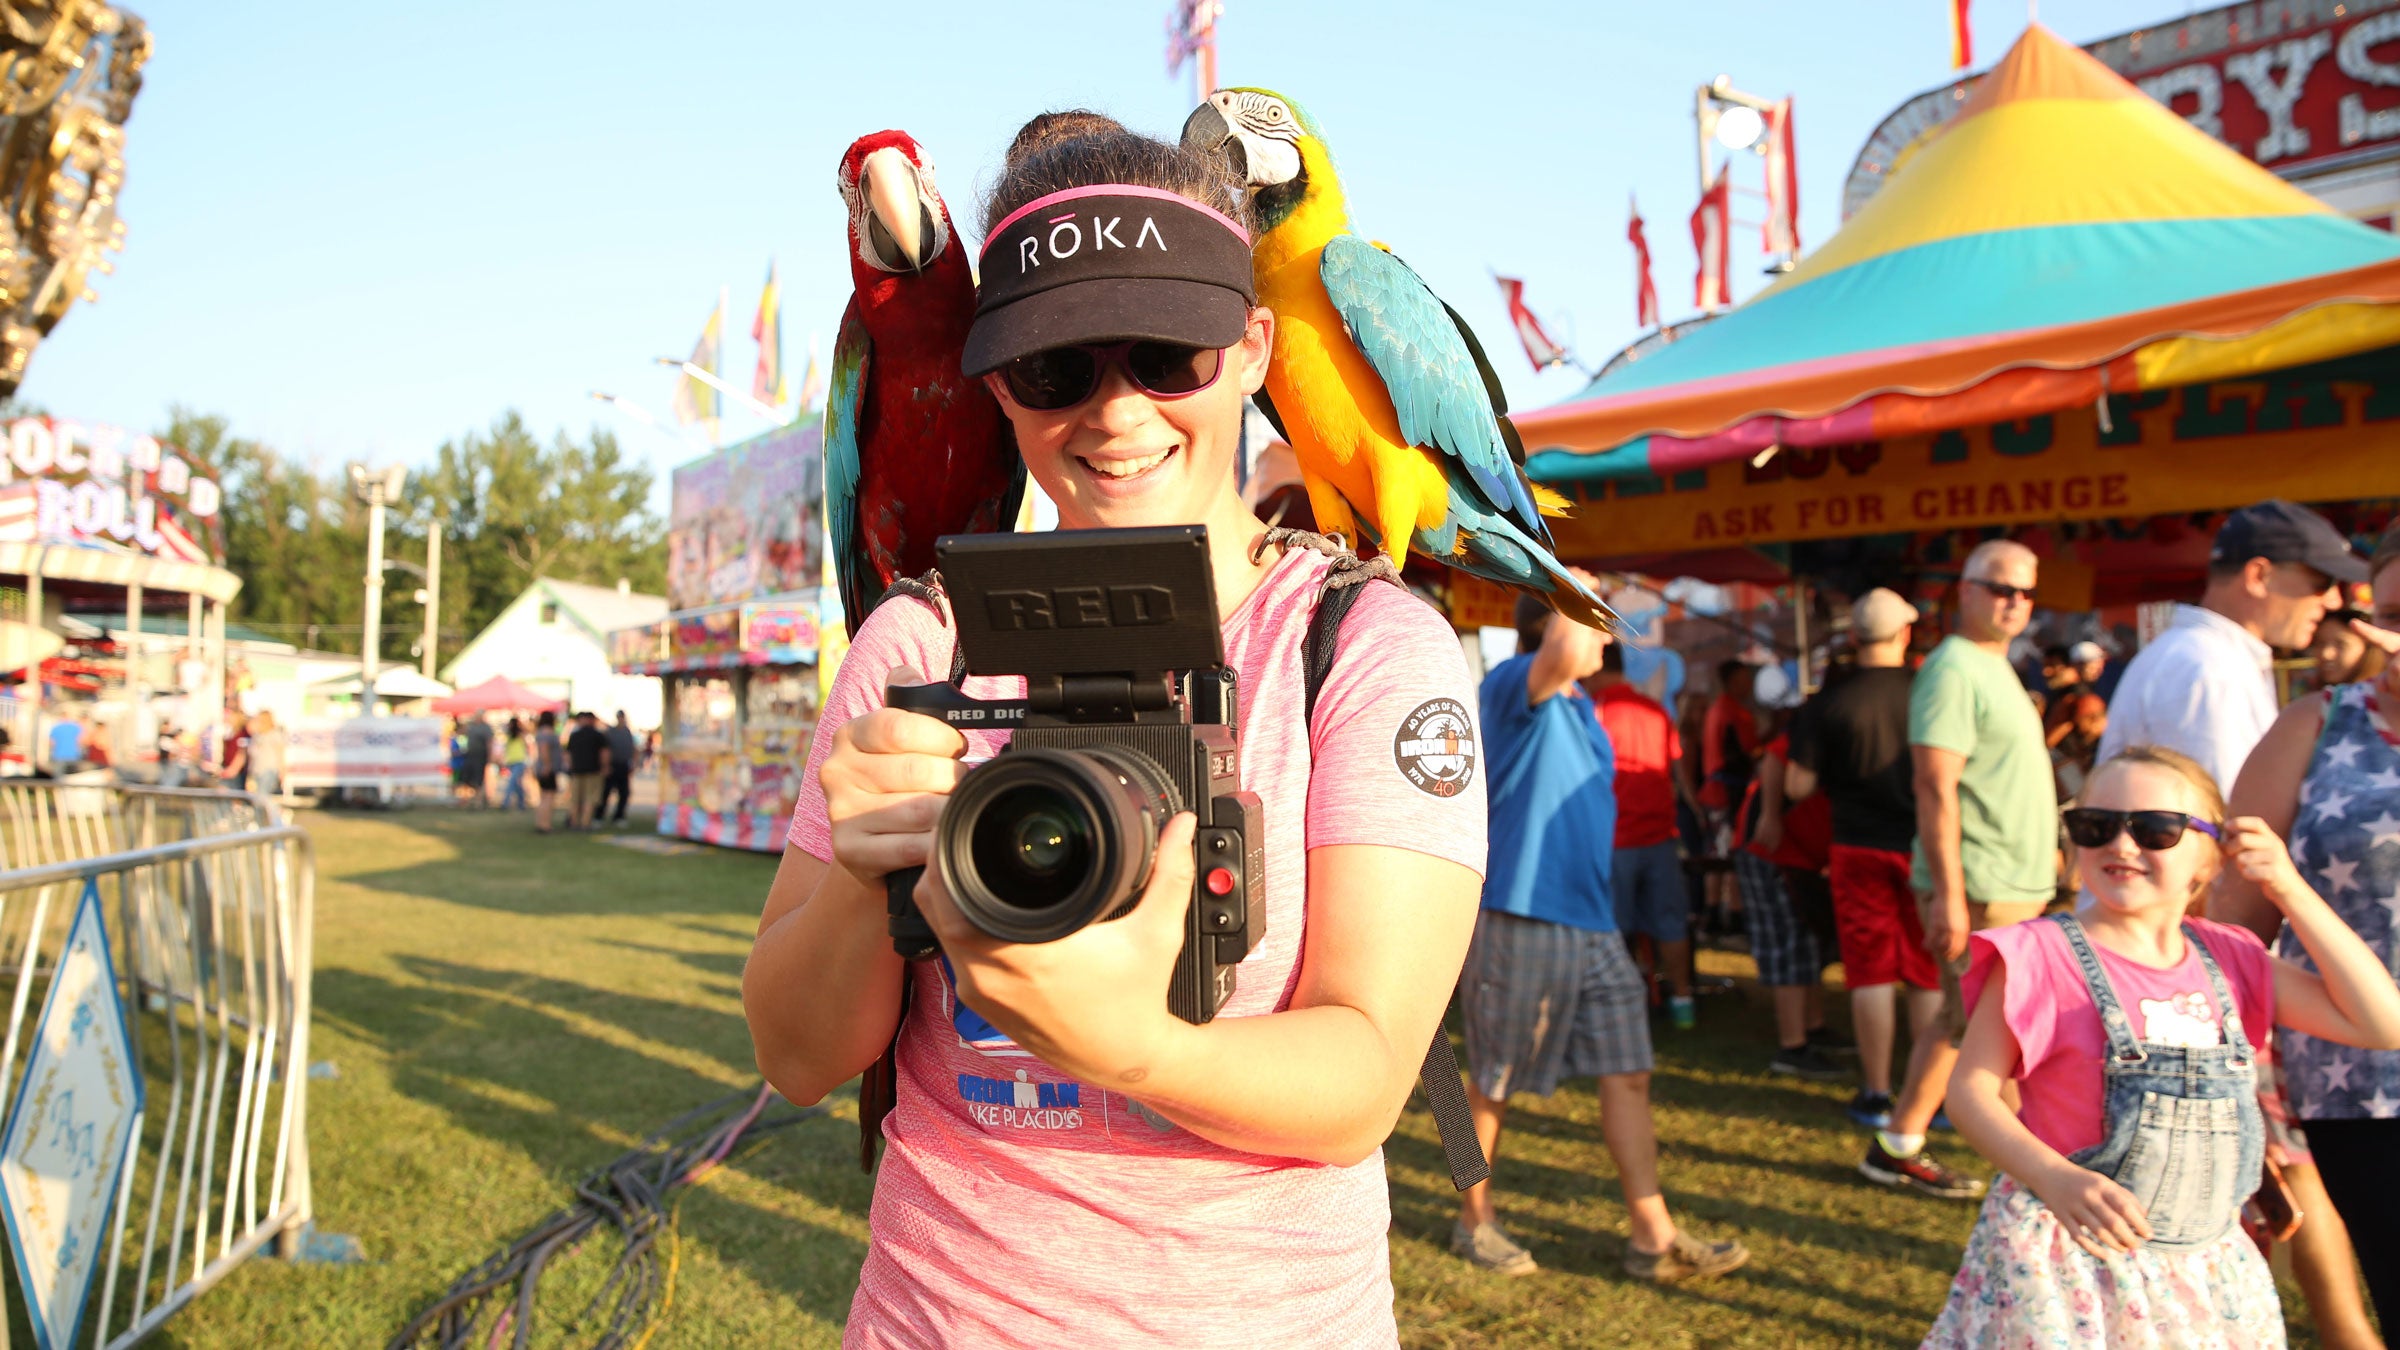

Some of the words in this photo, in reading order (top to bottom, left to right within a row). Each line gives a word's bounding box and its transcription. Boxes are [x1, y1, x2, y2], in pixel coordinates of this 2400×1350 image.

[37, 478, 162, 551] ROLL
[1694, 506, 1774, 540] ASK
[1799, 494, 1886, 530] FOR
[1912, 474, 2130, 521] CHANGE
[986, 584, 1178, 631] RED
[947, 709, 985, 720] RED
[1408, 718, 1419, 731] 40
[1416, 702, 1440, 720] YEARS
[1441, 702, 1451, 711] OF
[1407, 767, 1425, 785] 1978
[1433, 778, 1456, 796] 40
[957, 1070, 1079, 1108] IRONMAN
[968, 1104, 999, 1126] AKE
